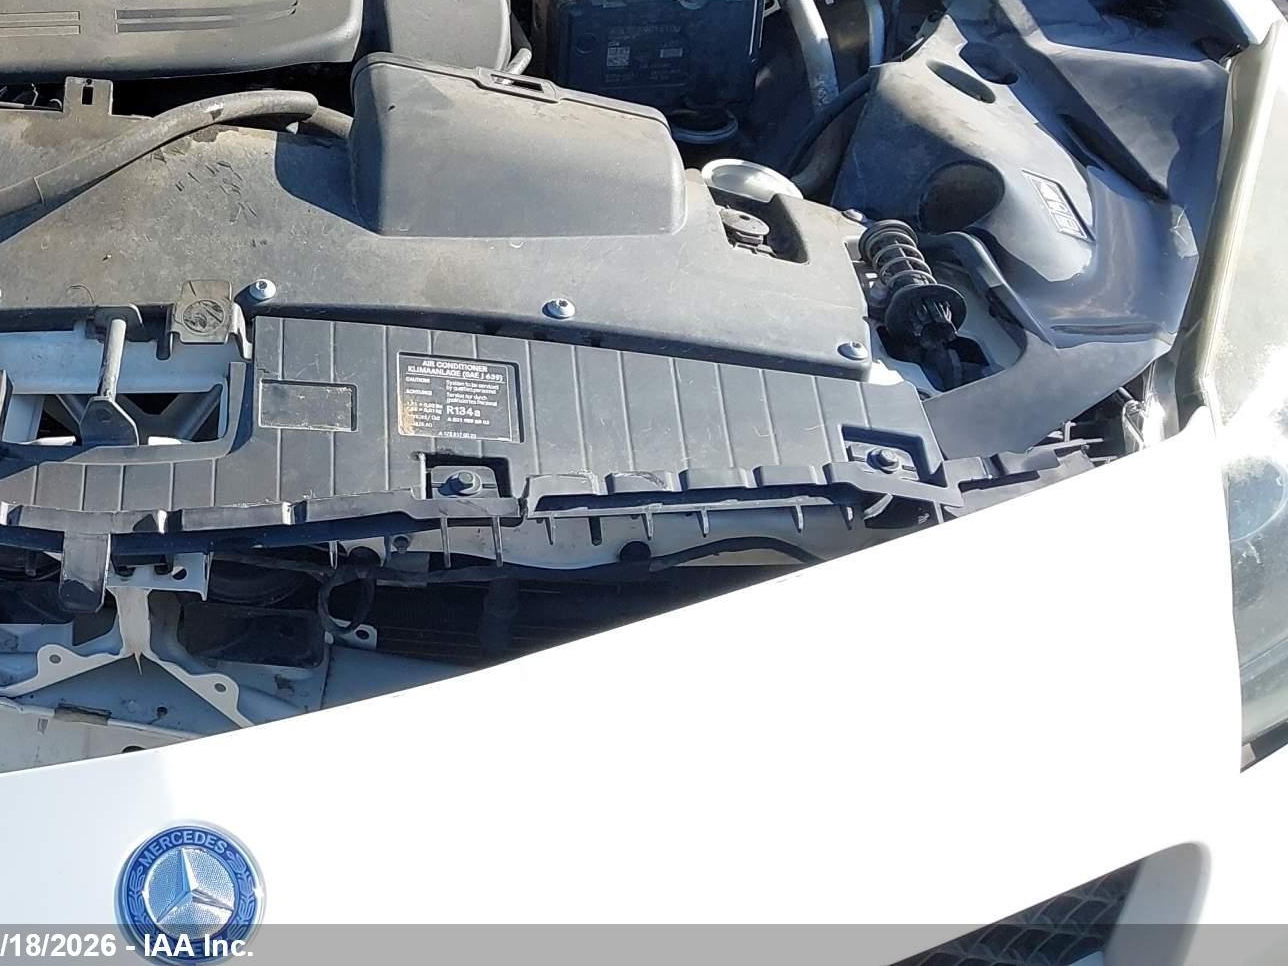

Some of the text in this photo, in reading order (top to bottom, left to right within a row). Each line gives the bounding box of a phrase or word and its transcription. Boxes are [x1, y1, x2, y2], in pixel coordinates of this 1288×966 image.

[407, 365, 461, 377] KLIMAANLAGE
[422, 360, 488, 372] AIR CONDITIONER
[138, 830, 228, 868] MERCEDES
